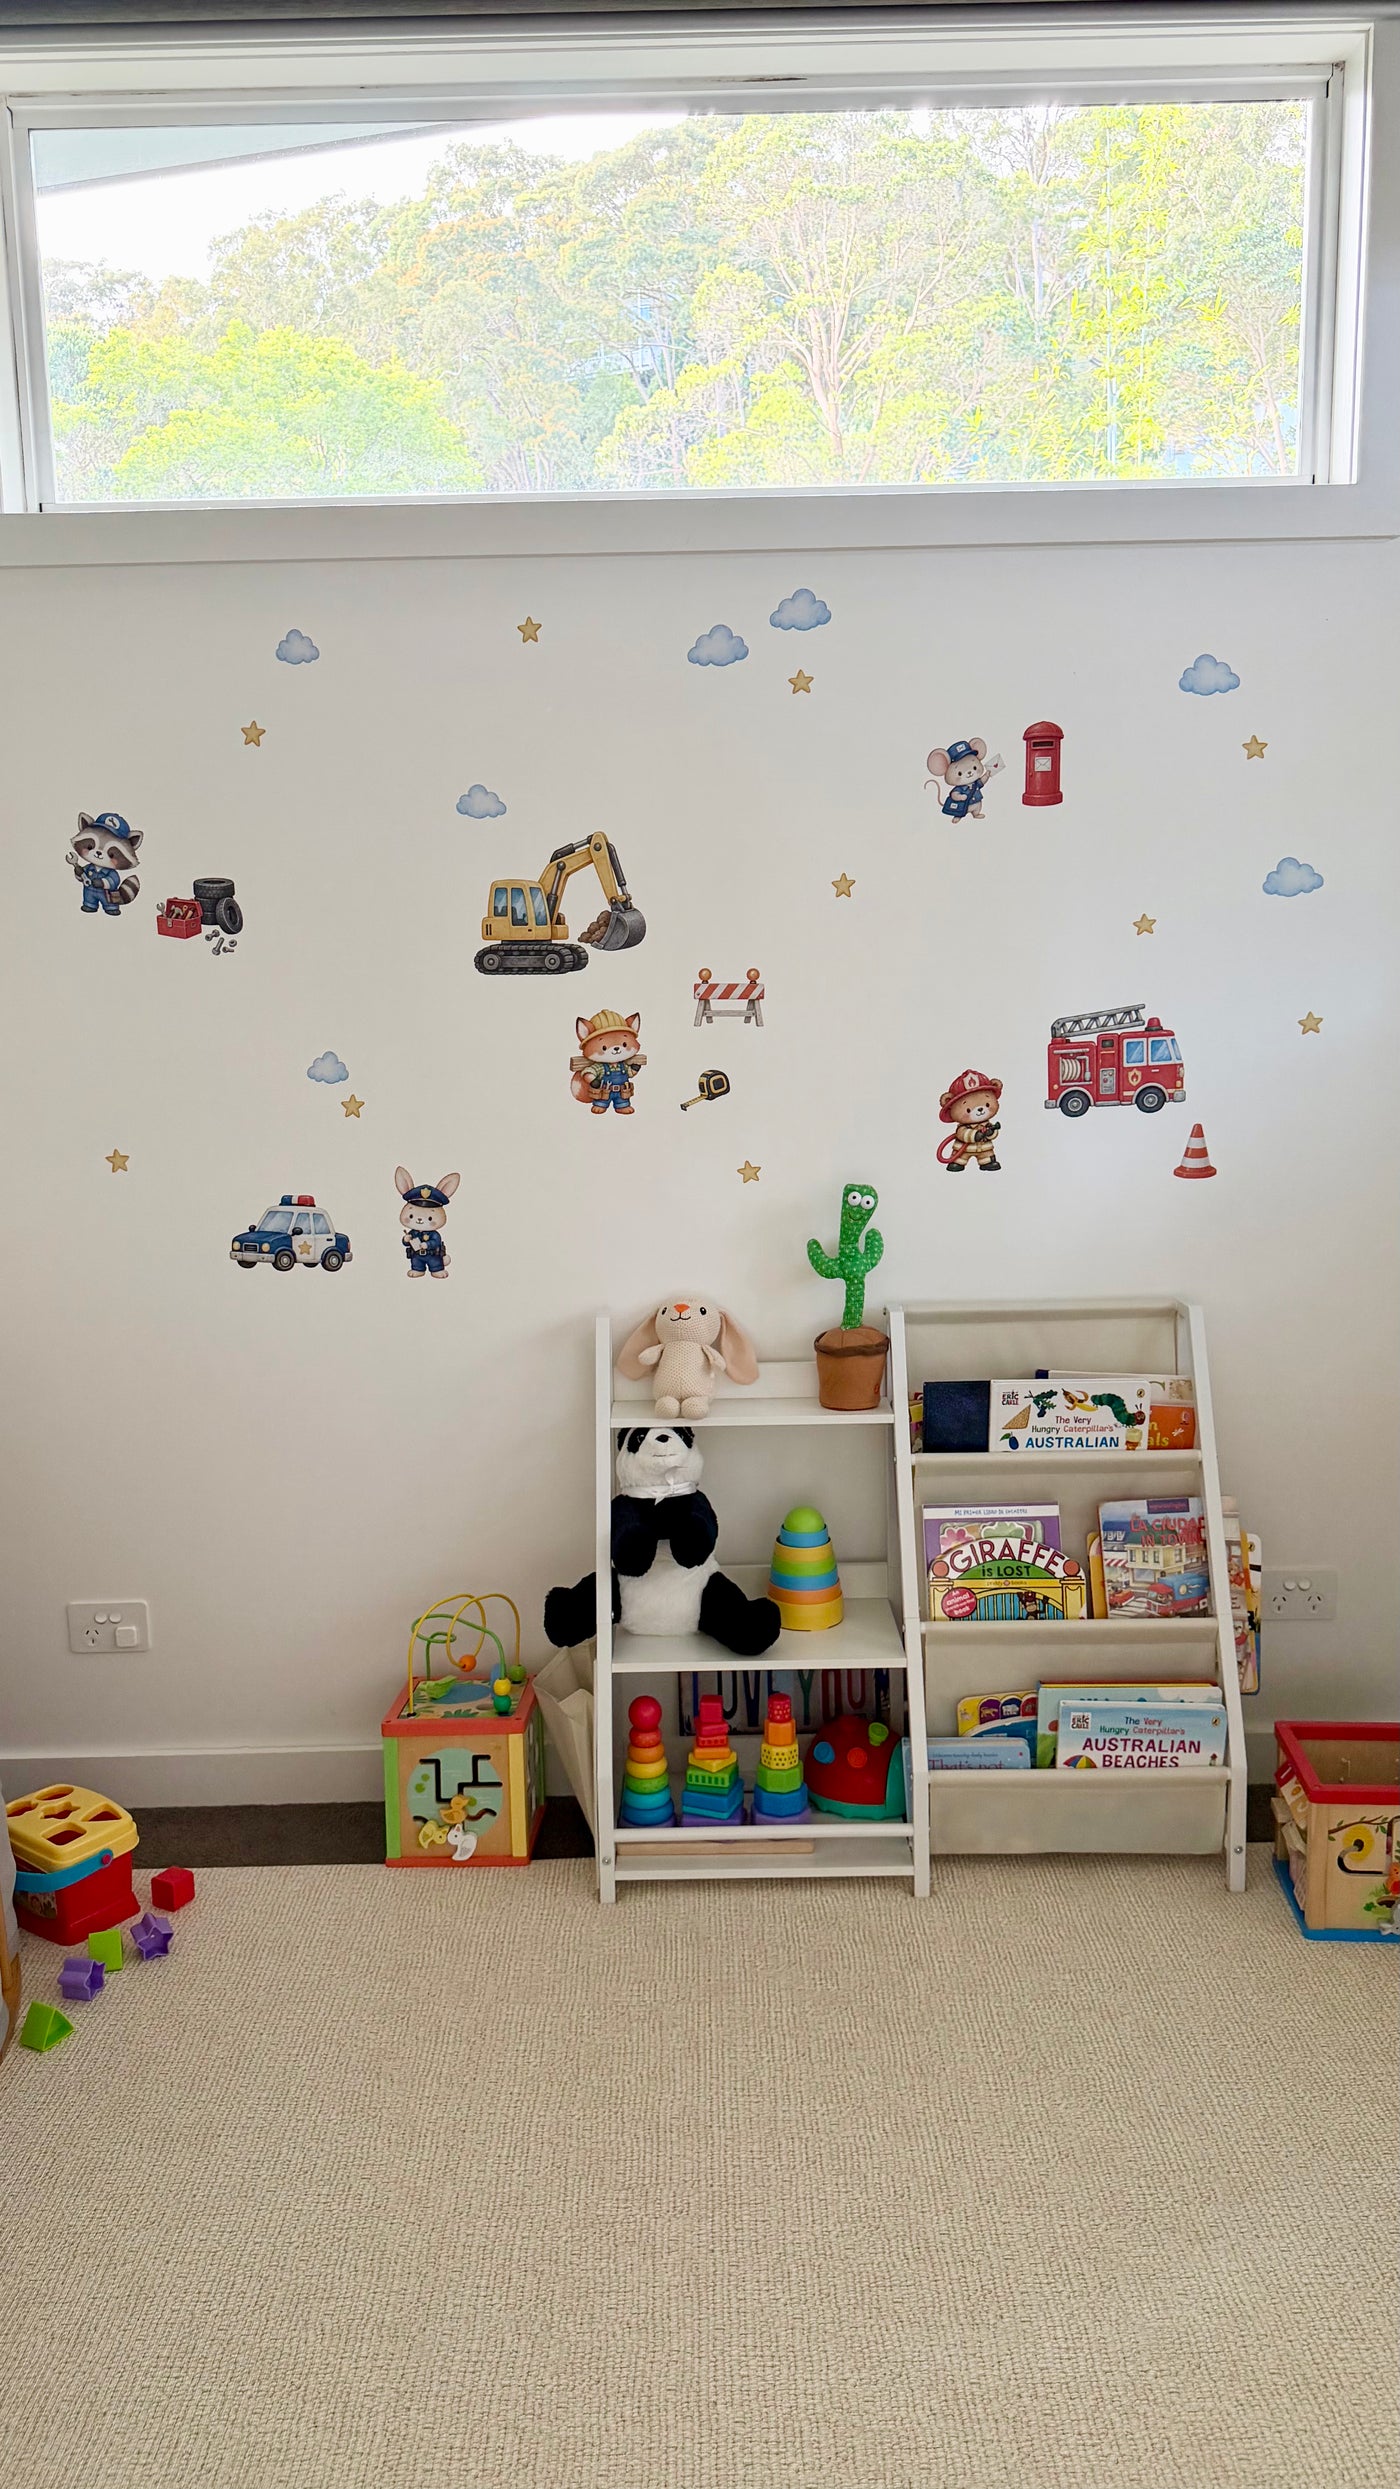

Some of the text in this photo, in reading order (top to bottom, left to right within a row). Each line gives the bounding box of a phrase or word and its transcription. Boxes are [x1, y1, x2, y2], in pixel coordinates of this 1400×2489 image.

[1055, 1416, 1092, 1425] The Very
[1032, 1424, 1114, 1435] Hungry Caterpillar's
[1025, 1436, 1119, 1449] AUSTRALIAN
[1130, 1517, 1147, 1532] LA
[1141, 1532, 1155, 1547] IN
[949, 1538, 1066, 1576] GIRAFFE
[981, 1565, 1032, 1577] is LOST
[1124, 1716, 1163, 1727] The Very
[1100, 1725, 1186, 1737] Hungry Caterpillar's
[1082, 1737, 1201, 1754] AUSTRALIAN
[1102, 1754, 1180, 1768] BEACHES
